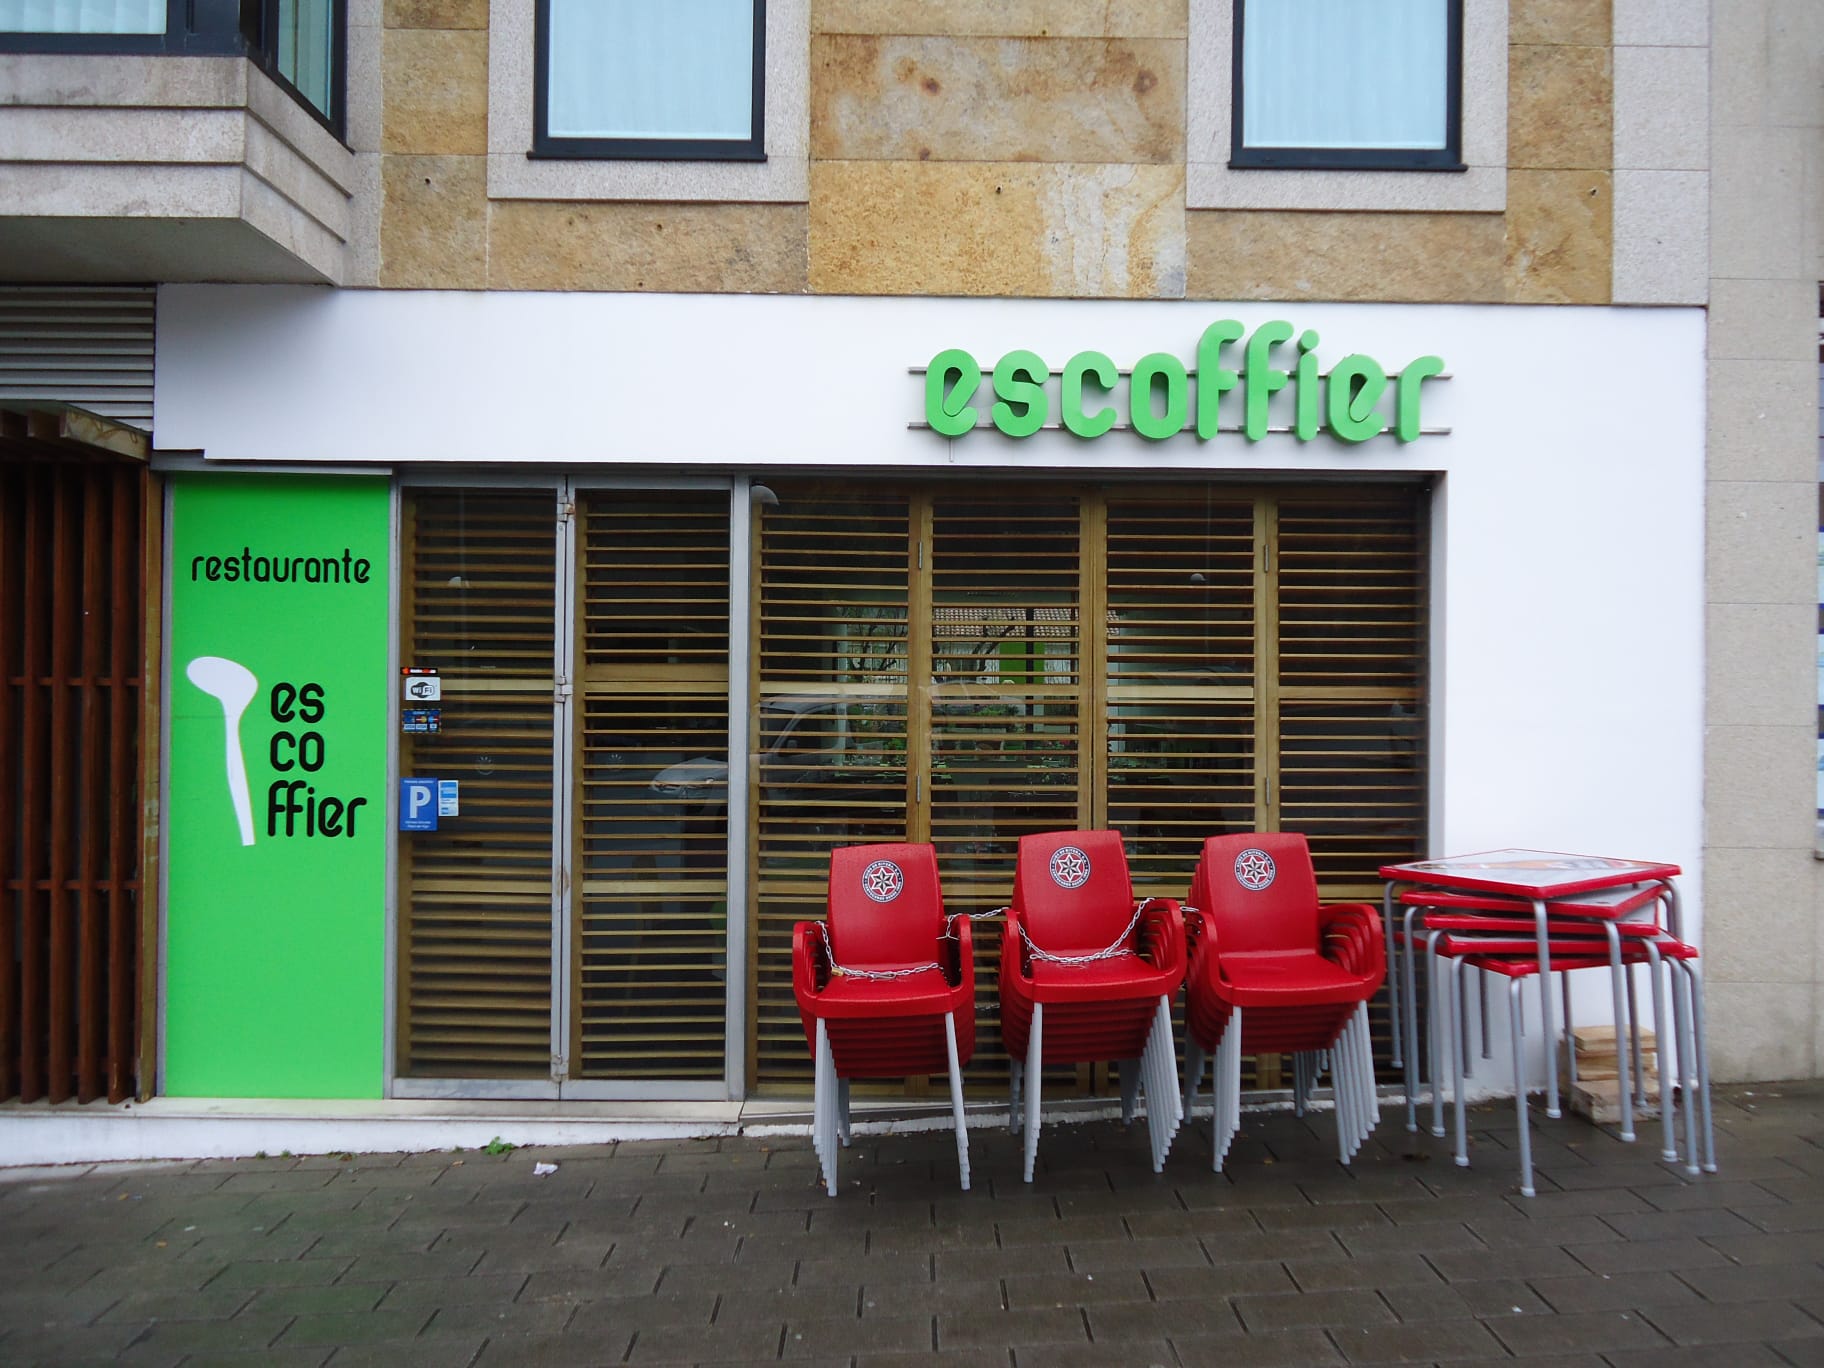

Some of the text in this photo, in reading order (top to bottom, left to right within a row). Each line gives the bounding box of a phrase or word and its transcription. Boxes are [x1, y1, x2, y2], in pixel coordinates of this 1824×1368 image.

[925, 320, 1444, 442] escoffier
[192, 547, 370, 583] restaurante
[271, 683, 324, 723] es
[270, 731, 324, 772] co
[268, 780, 367, 837] ffier
[410, 786, 431, 818] P
